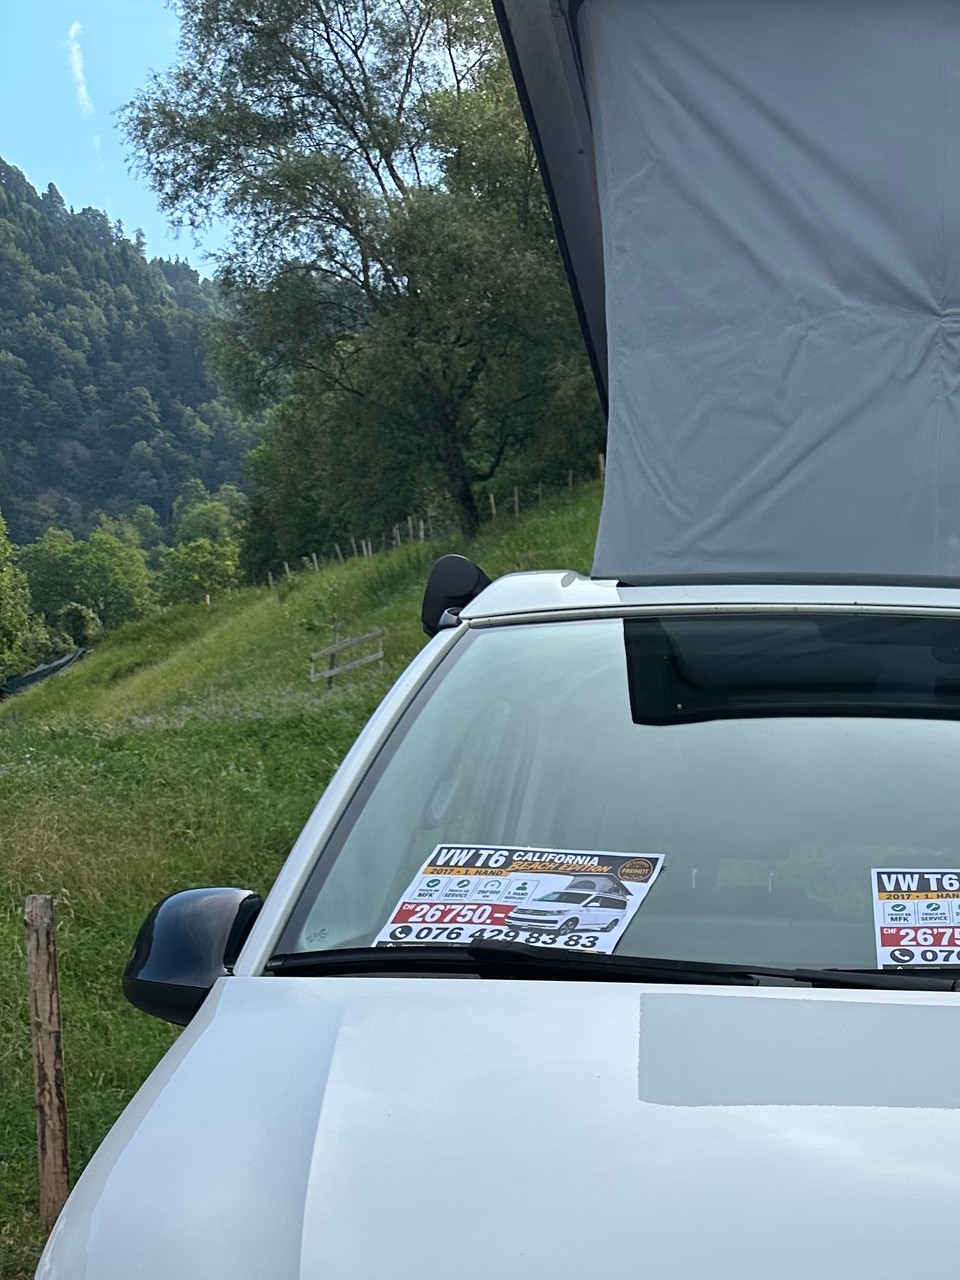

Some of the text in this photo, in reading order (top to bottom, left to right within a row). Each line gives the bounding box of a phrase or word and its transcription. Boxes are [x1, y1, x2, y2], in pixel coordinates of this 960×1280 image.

[436, 848, 509, 868] VW T6
[508, 860, 558, 871] BEACH
[558, 862, 611, 873] EDITION
[512, 851, 599, 866] CALIFORNIA
[881, 873, 960, 892] VW T6
[408, 904, 506, 924] 26'750.-
[415, 926, 599, 949] 076 429 83 83
